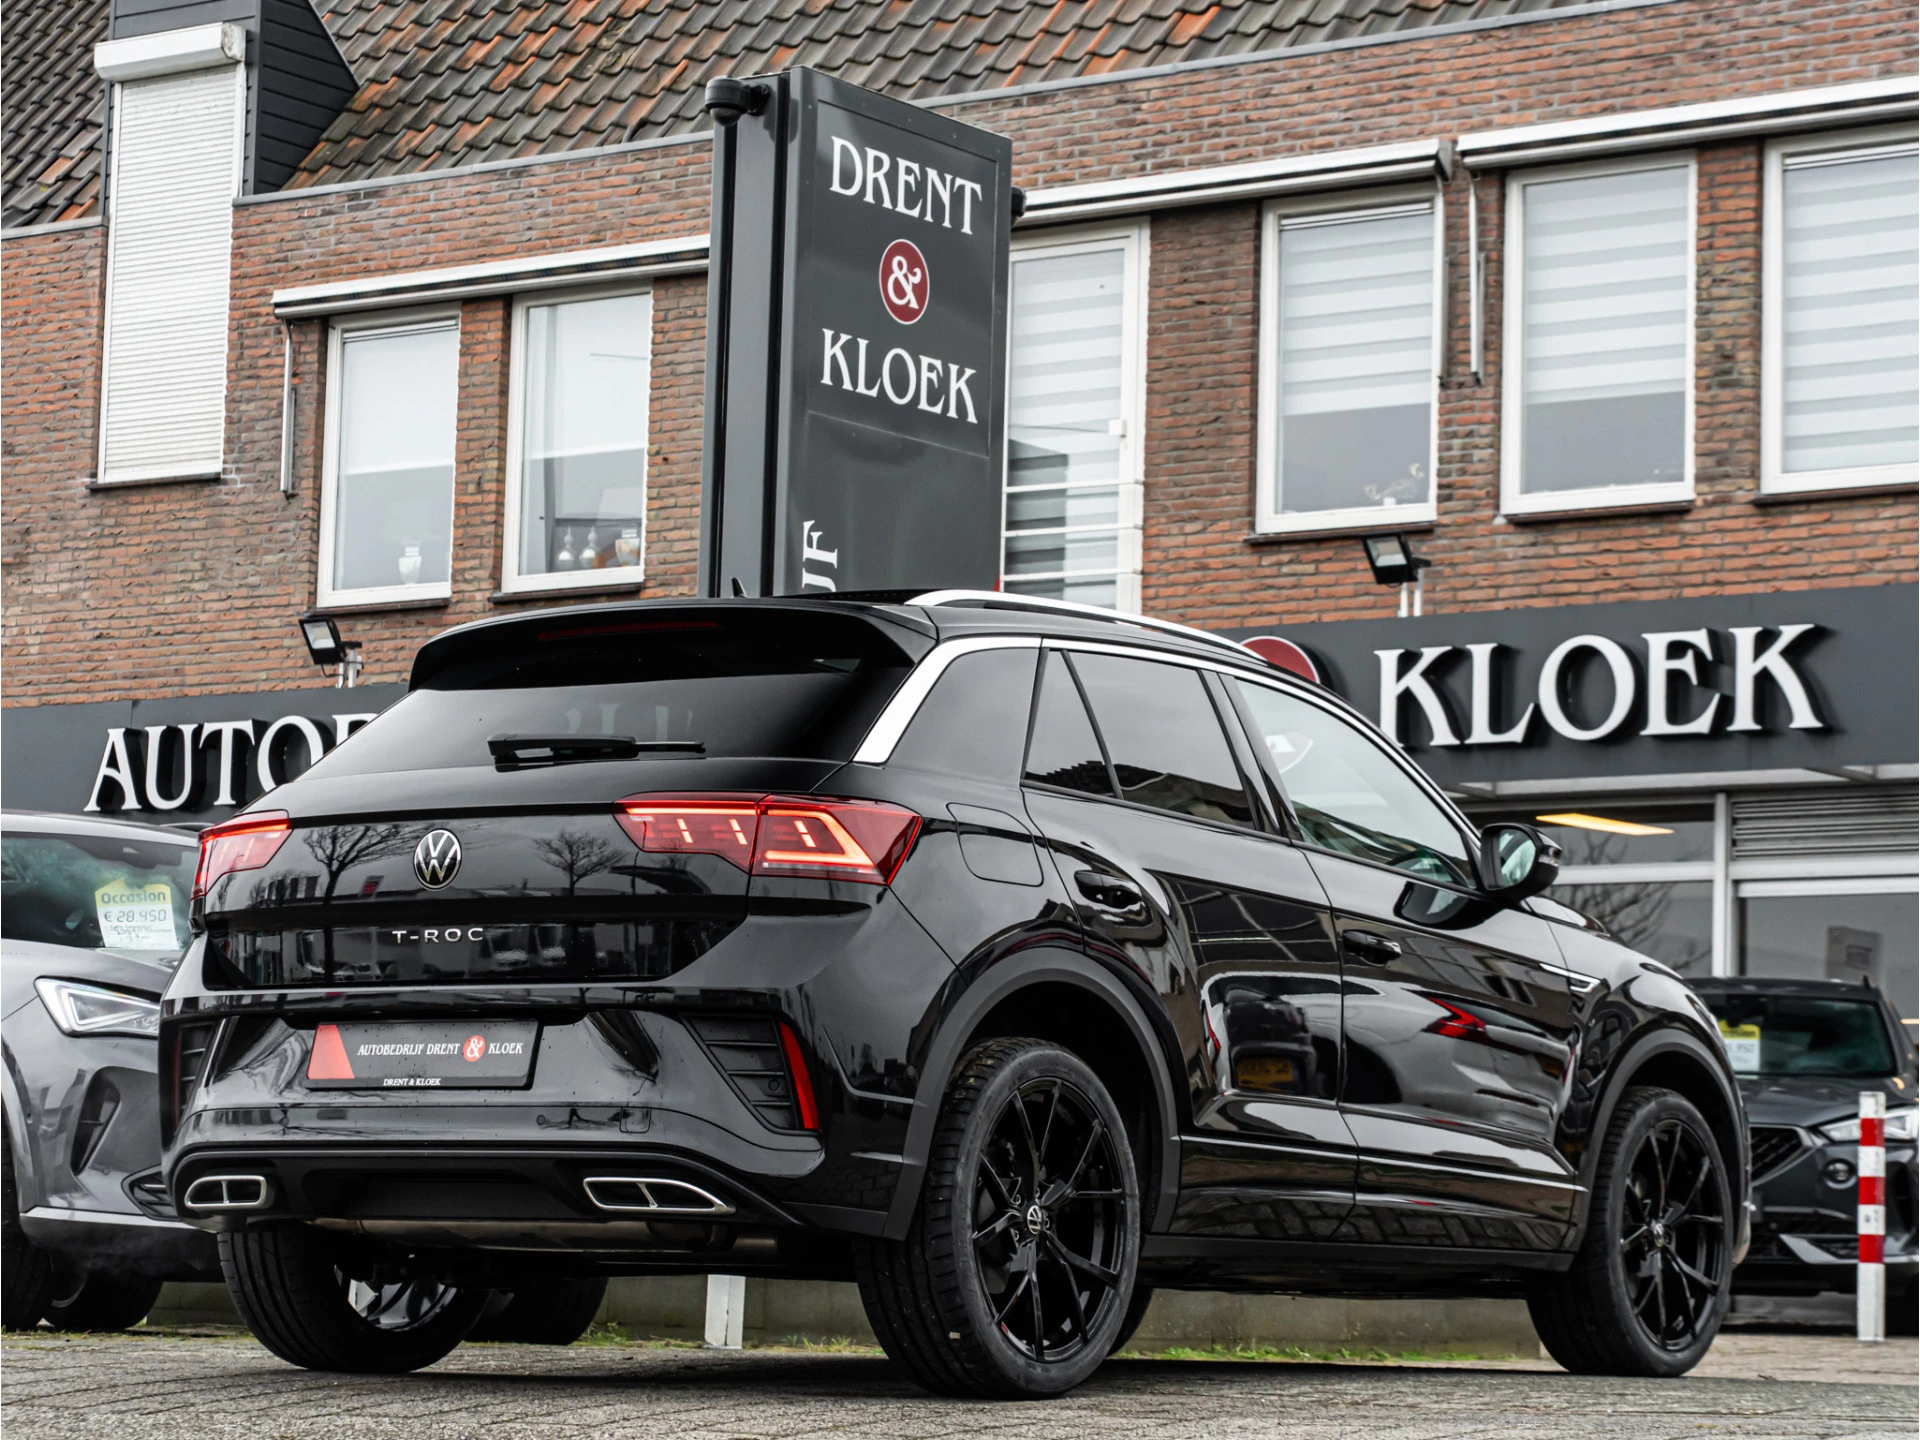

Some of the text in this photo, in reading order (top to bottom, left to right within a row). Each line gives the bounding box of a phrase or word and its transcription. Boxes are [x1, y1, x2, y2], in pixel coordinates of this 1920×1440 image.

[829, 135, 983, 236] DRENT
[887, 255, 922, 310] &
[820, 327, 979, 425] KLOEK
[1373, 623, 1824, 747] KLOEK
[100, 891, 167, 905] Occasion
[116, 909, 167, 923] 28.450
[391, 927, 484, 944] T-ROC
[357, 1037, 523, 1058] AUTOBEDRIJF DRENT & KLOEK
[383, 1077, 441, 1086] DRENT & KLOEK
